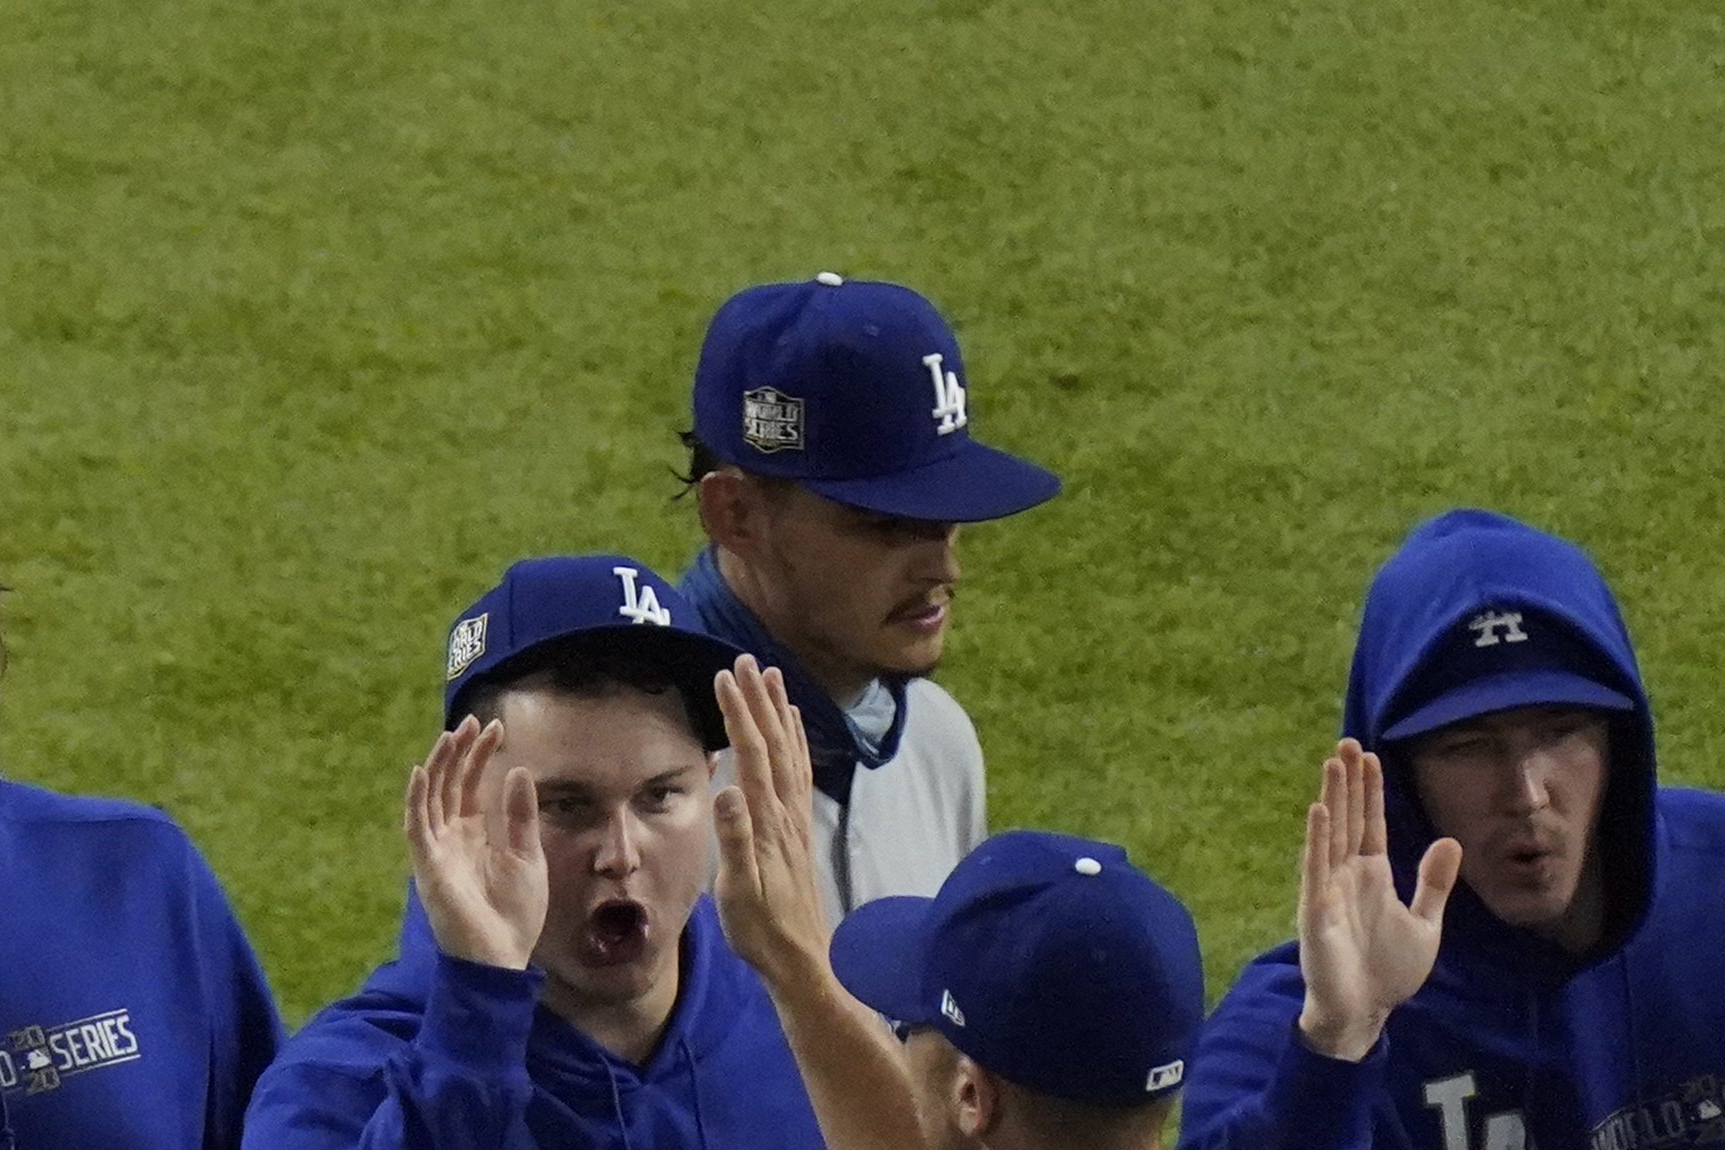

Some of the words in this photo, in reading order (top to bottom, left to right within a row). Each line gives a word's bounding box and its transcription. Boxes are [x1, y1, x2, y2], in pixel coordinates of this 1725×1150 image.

[922, 353, 967, 435] LA
[613, 567, 671, 626] LA
[49, 1015, 139, 1071] SERIES
